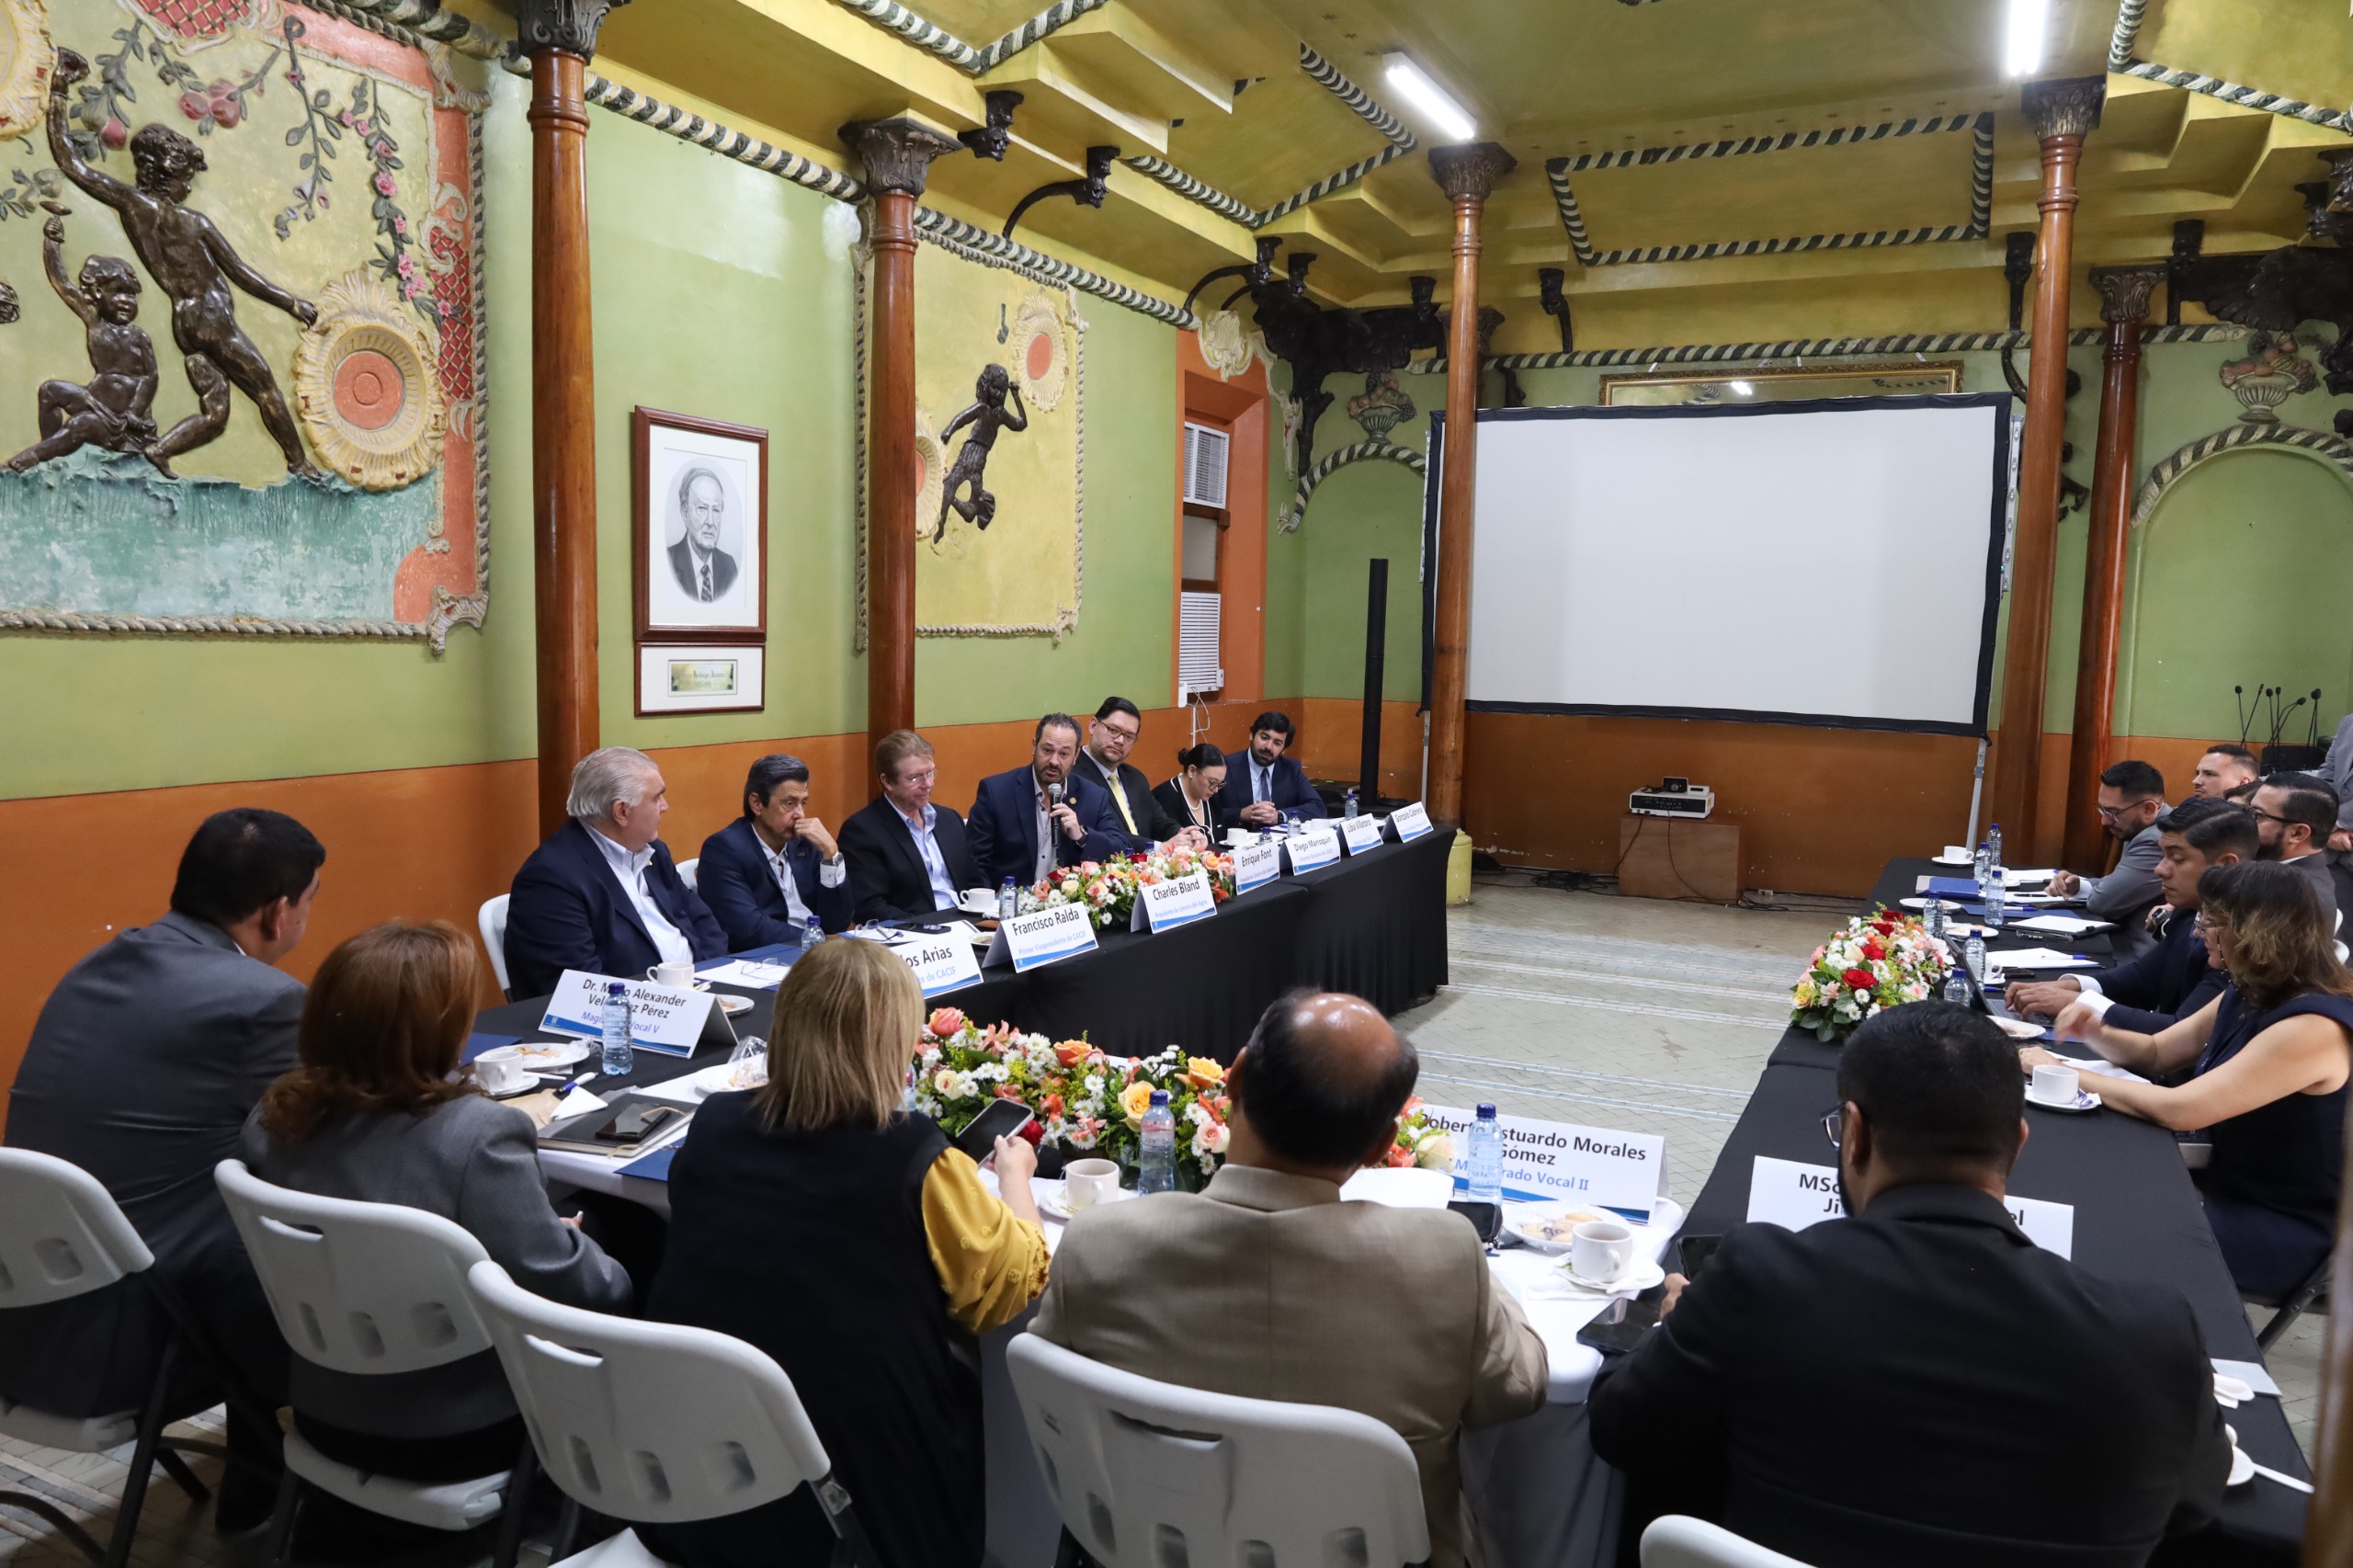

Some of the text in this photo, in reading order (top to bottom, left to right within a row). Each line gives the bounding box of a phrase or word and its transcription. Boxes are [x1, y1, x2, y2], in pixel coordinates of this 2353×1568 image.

[1294, 842, 1308, 852] Diego
[1242, 848, 1272, 867] Enrique Font
[1152, 878, 1200, 902] Charles Bland
[1012, 907, 1080, 937] Francisco Ralda
[1017, 947, 1034, 955] Primer
[1035, 937, 1067, 951] Vicepresidente
[1072, 930, 1086, 940] CACIF
[922, 946, 953, 964] Arias
[926, 972, 936, 983] de
[936, 966, 957, 979] CACIF
[583, 978, 597, 992] Dr.
[632, 988, 688, 1007] Alexander
[640, 1004, 670, 1019] Pérez
[652, 1025, 661, 1034] V
[1502, 1129, 1568, 1150] stuardo
[1573, 1136, 1647, 1162] Morales
[1537, 1172, 1574, 1188] Vocal
[1578, 1178, 1589, 1191] II
